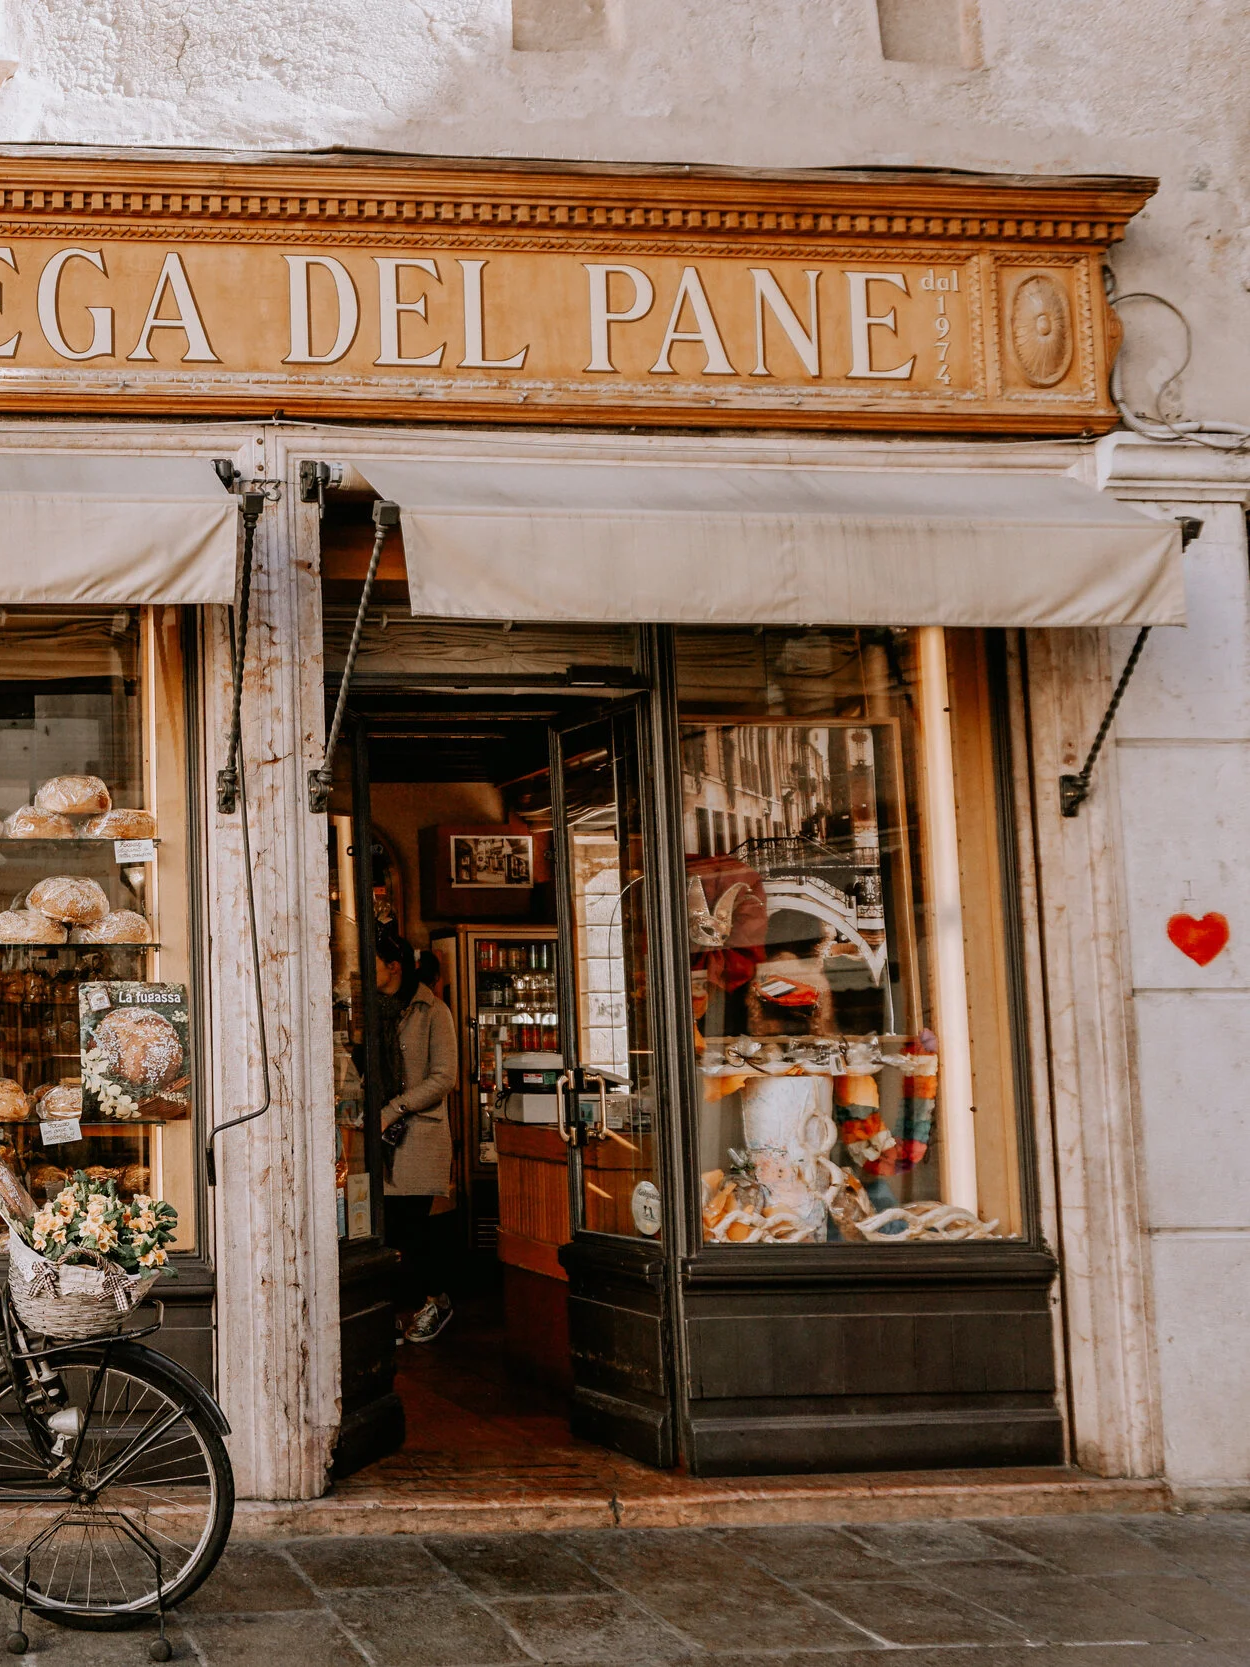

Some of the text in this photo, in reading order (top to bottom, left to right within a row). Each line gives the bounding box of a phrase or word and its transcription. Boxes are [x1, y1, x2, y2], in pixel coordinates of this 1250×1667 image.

[919, 268, 961, 292] dal
[281, 253, 530, 370] DEL
[581, 262, 917, 381] PANE
[933, 294, 952, 386] 1974
[119, 990, 182, 1005] La fugassa
